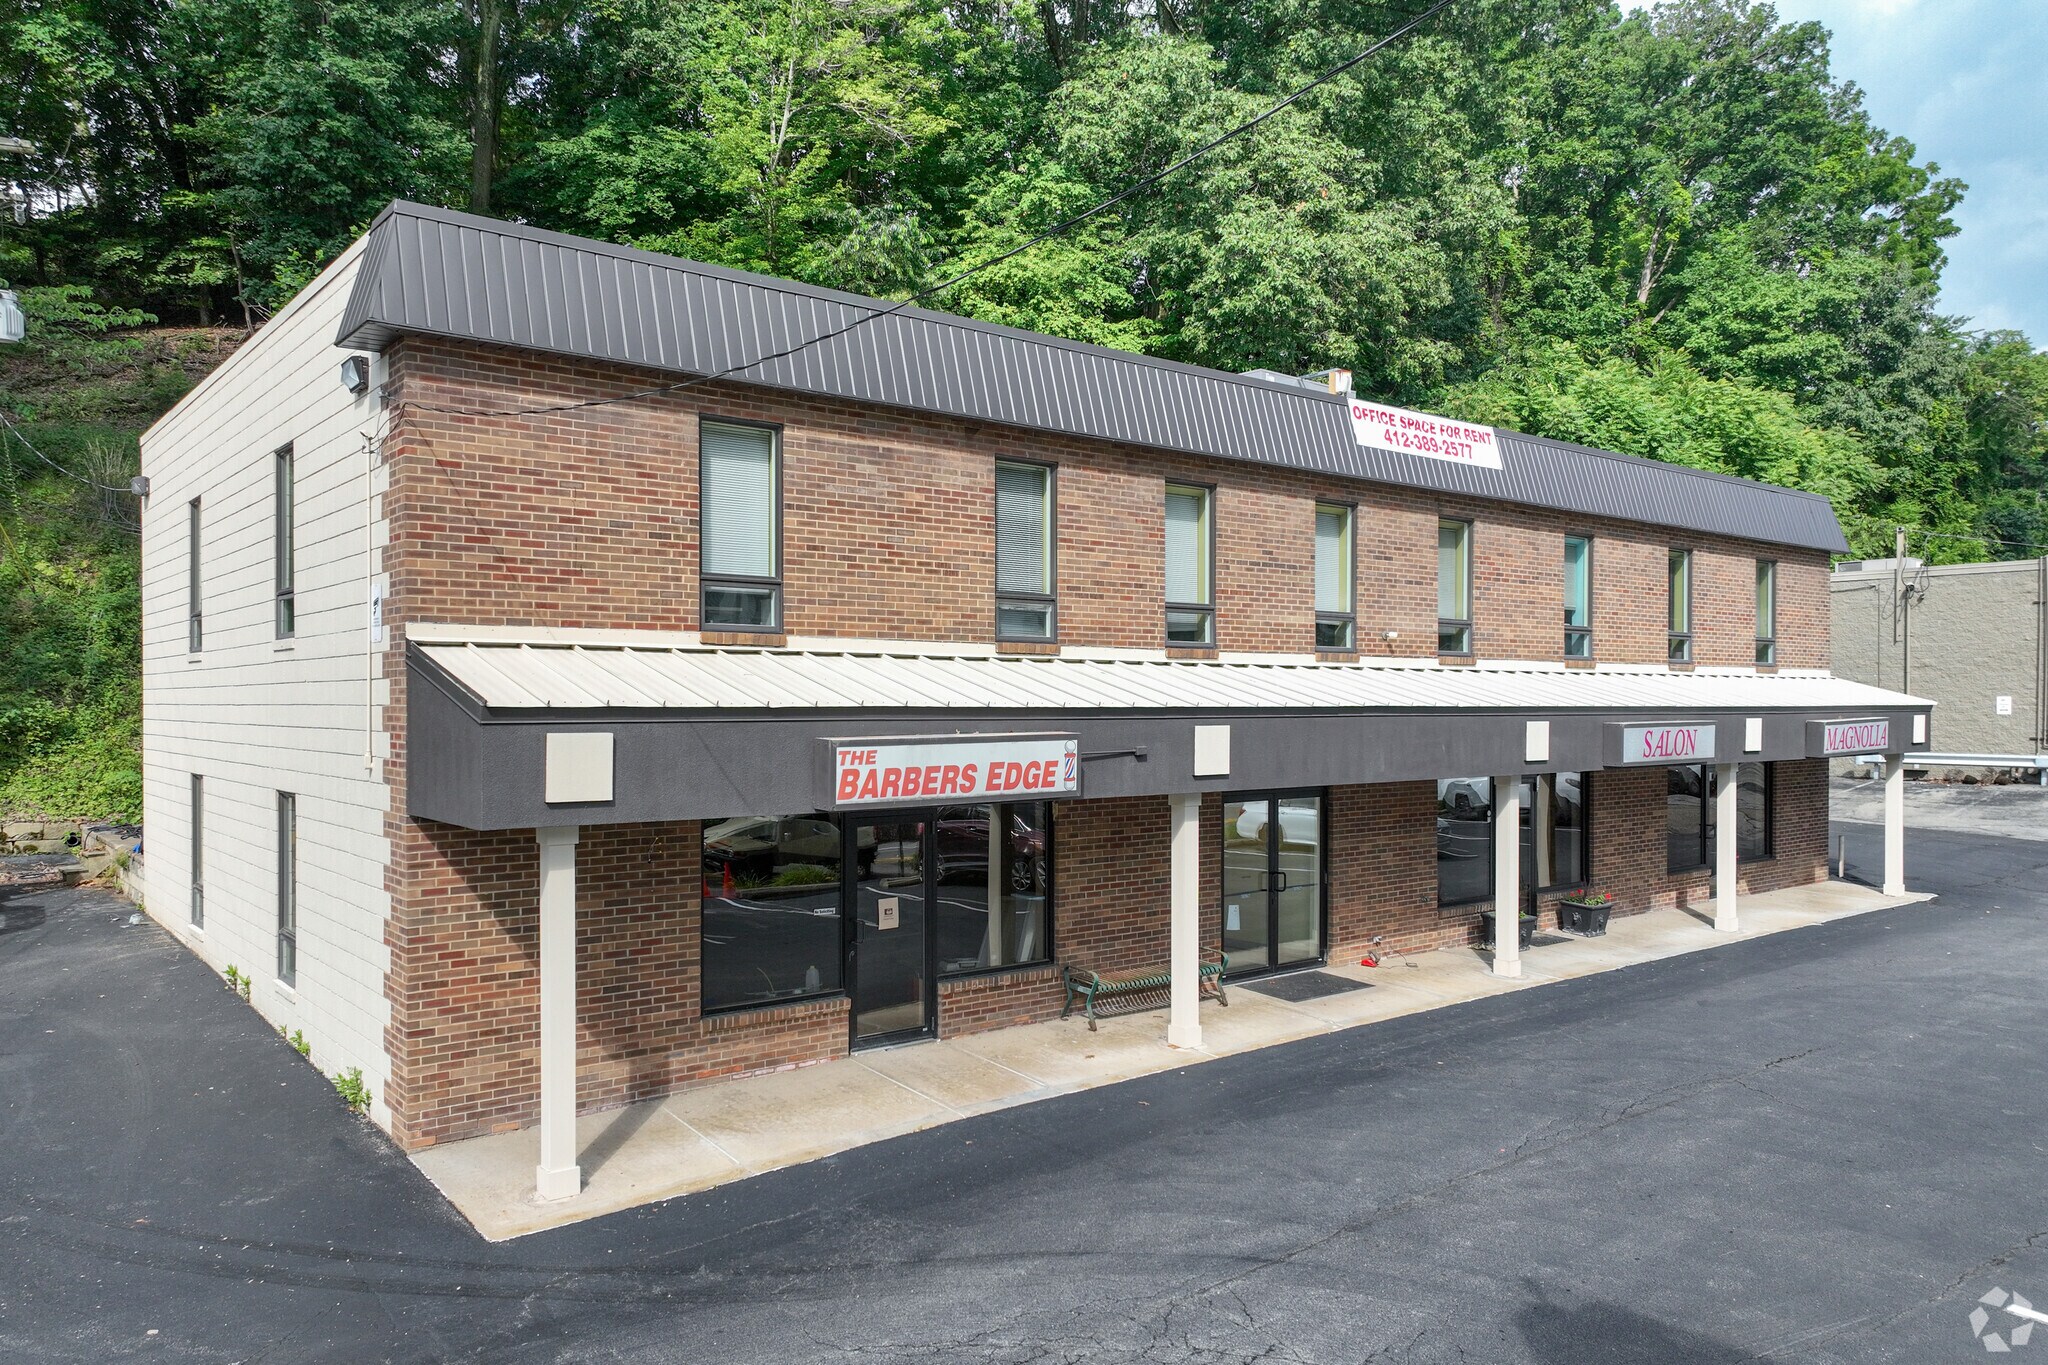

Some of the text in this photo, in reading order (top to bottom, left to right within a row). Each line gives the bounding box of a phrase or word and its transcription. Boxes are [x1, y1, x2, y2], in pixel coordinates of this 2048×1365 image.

[1353, 405, 1491, 445] OFFICE SPACE FOR RENT
[1384, 428, 1472, 460] 412-389-2577
[1643, 729, 1698, 758] SALON
[1825, 724, 1888, 751] MAGNOLIA
[838, 750, 877, 766] THE
[837, 760, 1059, 801] BARBERS EDGE
